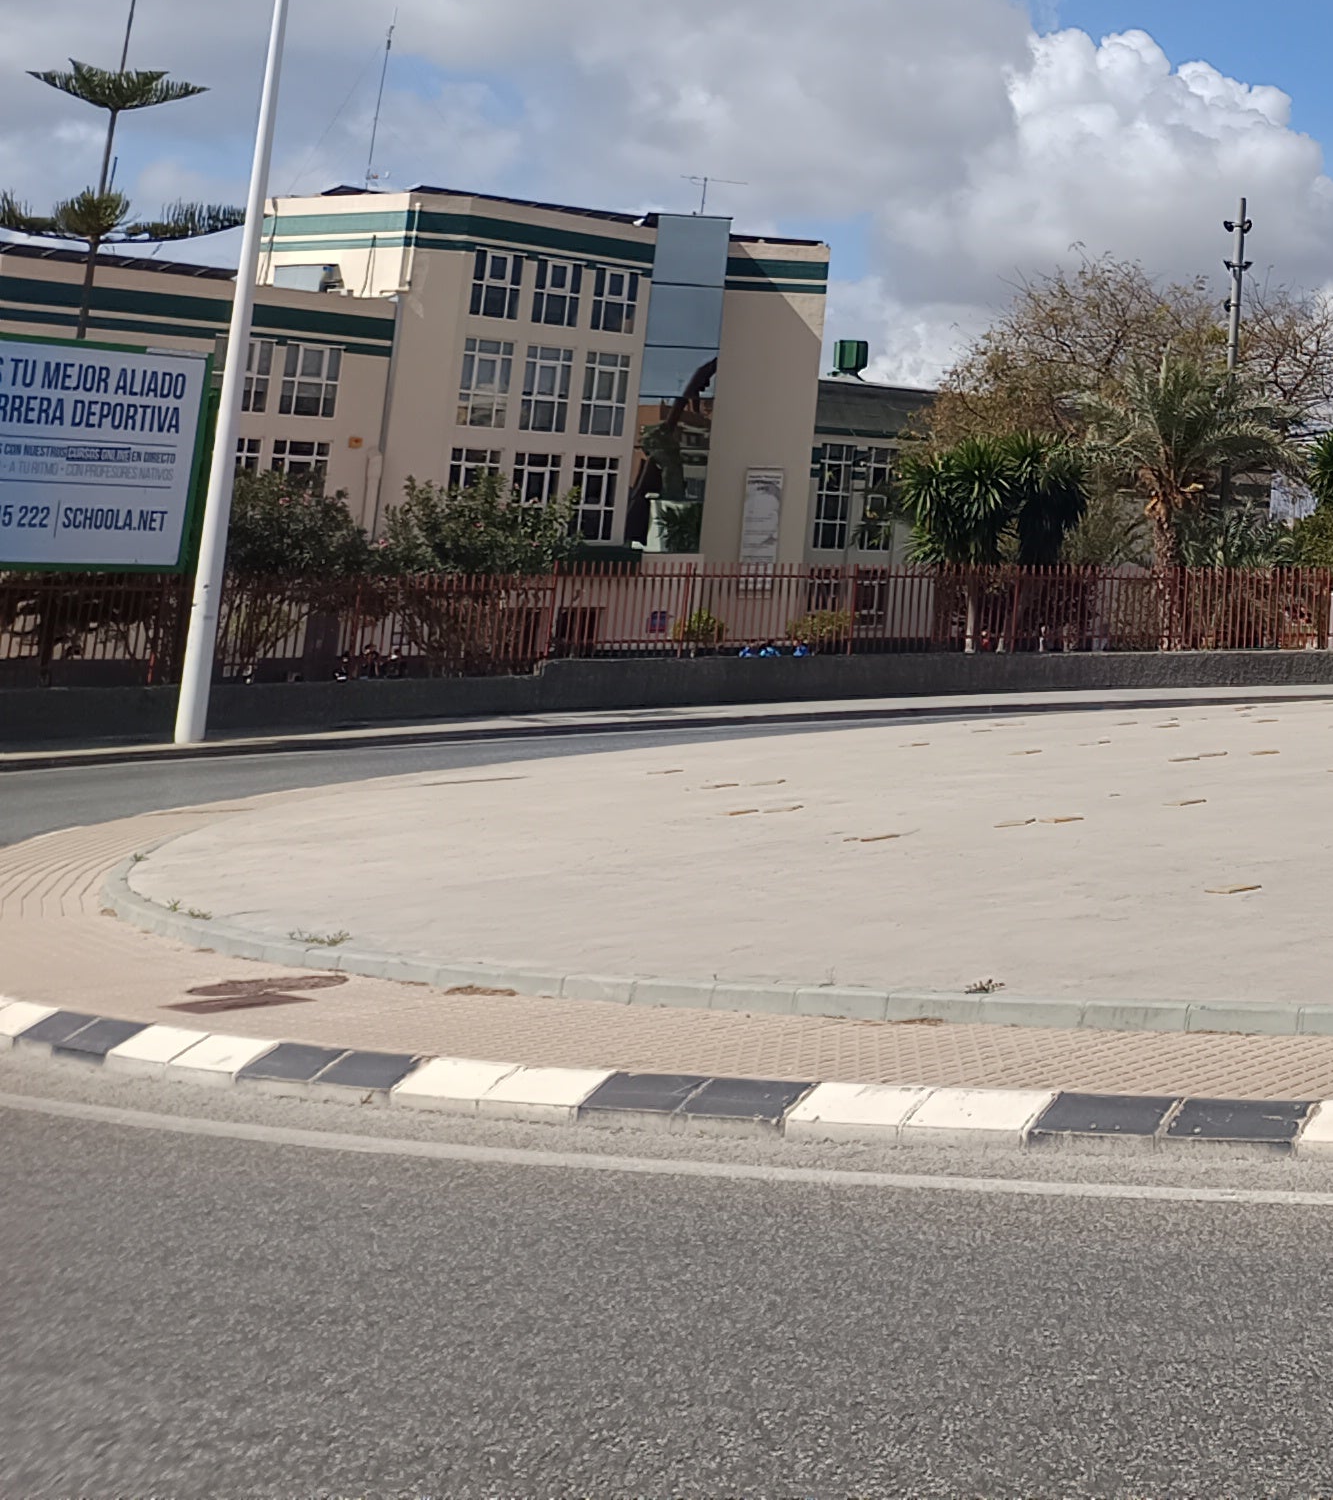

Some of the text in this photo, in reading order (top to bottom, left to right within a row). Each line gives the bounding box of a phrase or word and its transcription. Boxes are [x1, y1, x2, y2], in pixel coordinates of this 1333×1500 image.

[11, 358, 36, 388] TU
[41, 361, 110, 393] MEJOR
[114, 368, 186, 400] ALIADO
[71, 399, 180, 434] DEPORTIVA
[4, 443, 21, 456] CON
[23, 444, 67, 459] NUESTROS
[68, 447, 101, 461] CURSOS
[131, 450, 142, 462] EN
[143, 451, 176, 464] DIRECTO
[31, 461, 58, 476] RITMO
[84, 464, 138, 480] PROFESORES
[139, 467, 174, 481] NATIVOS
[0, 504, 168, 533] 5 222 SCHOOLA.NET
